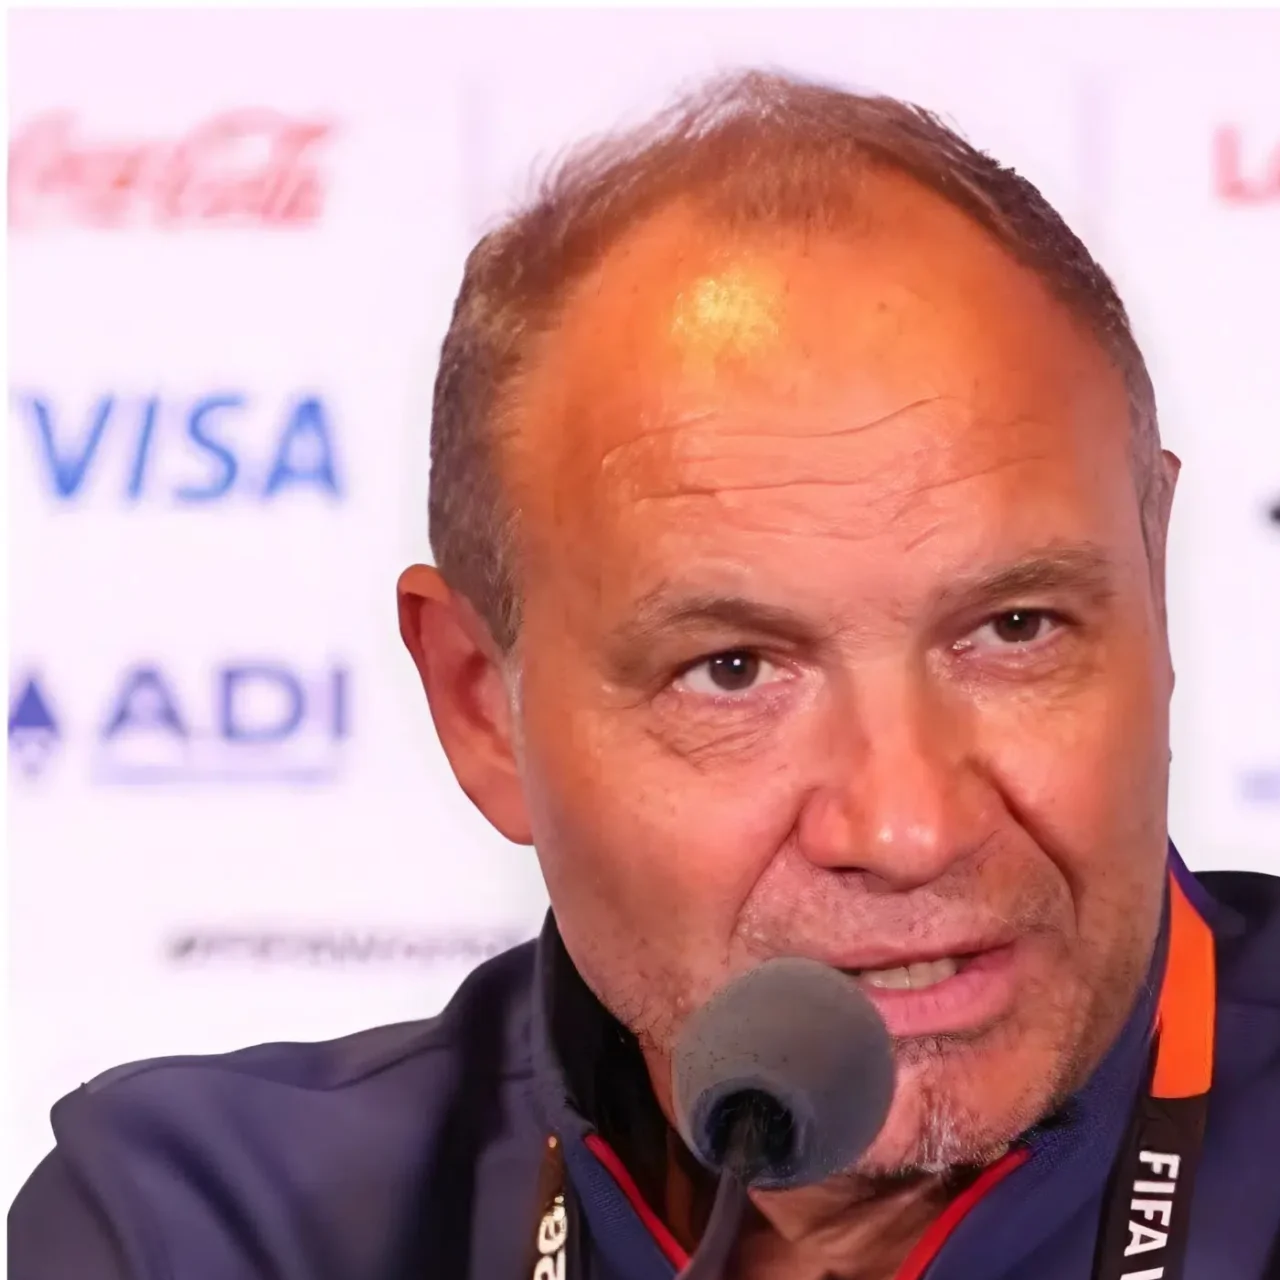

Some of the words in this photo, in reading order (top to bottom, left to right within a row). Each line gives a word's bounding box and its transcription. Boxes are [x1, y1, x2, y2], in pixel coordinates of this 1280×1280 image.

[22, 393, 341, 502] VISA
[102, 664, 349, 743] ADI
[1123, 1150, 1181, 1257] FIFA
